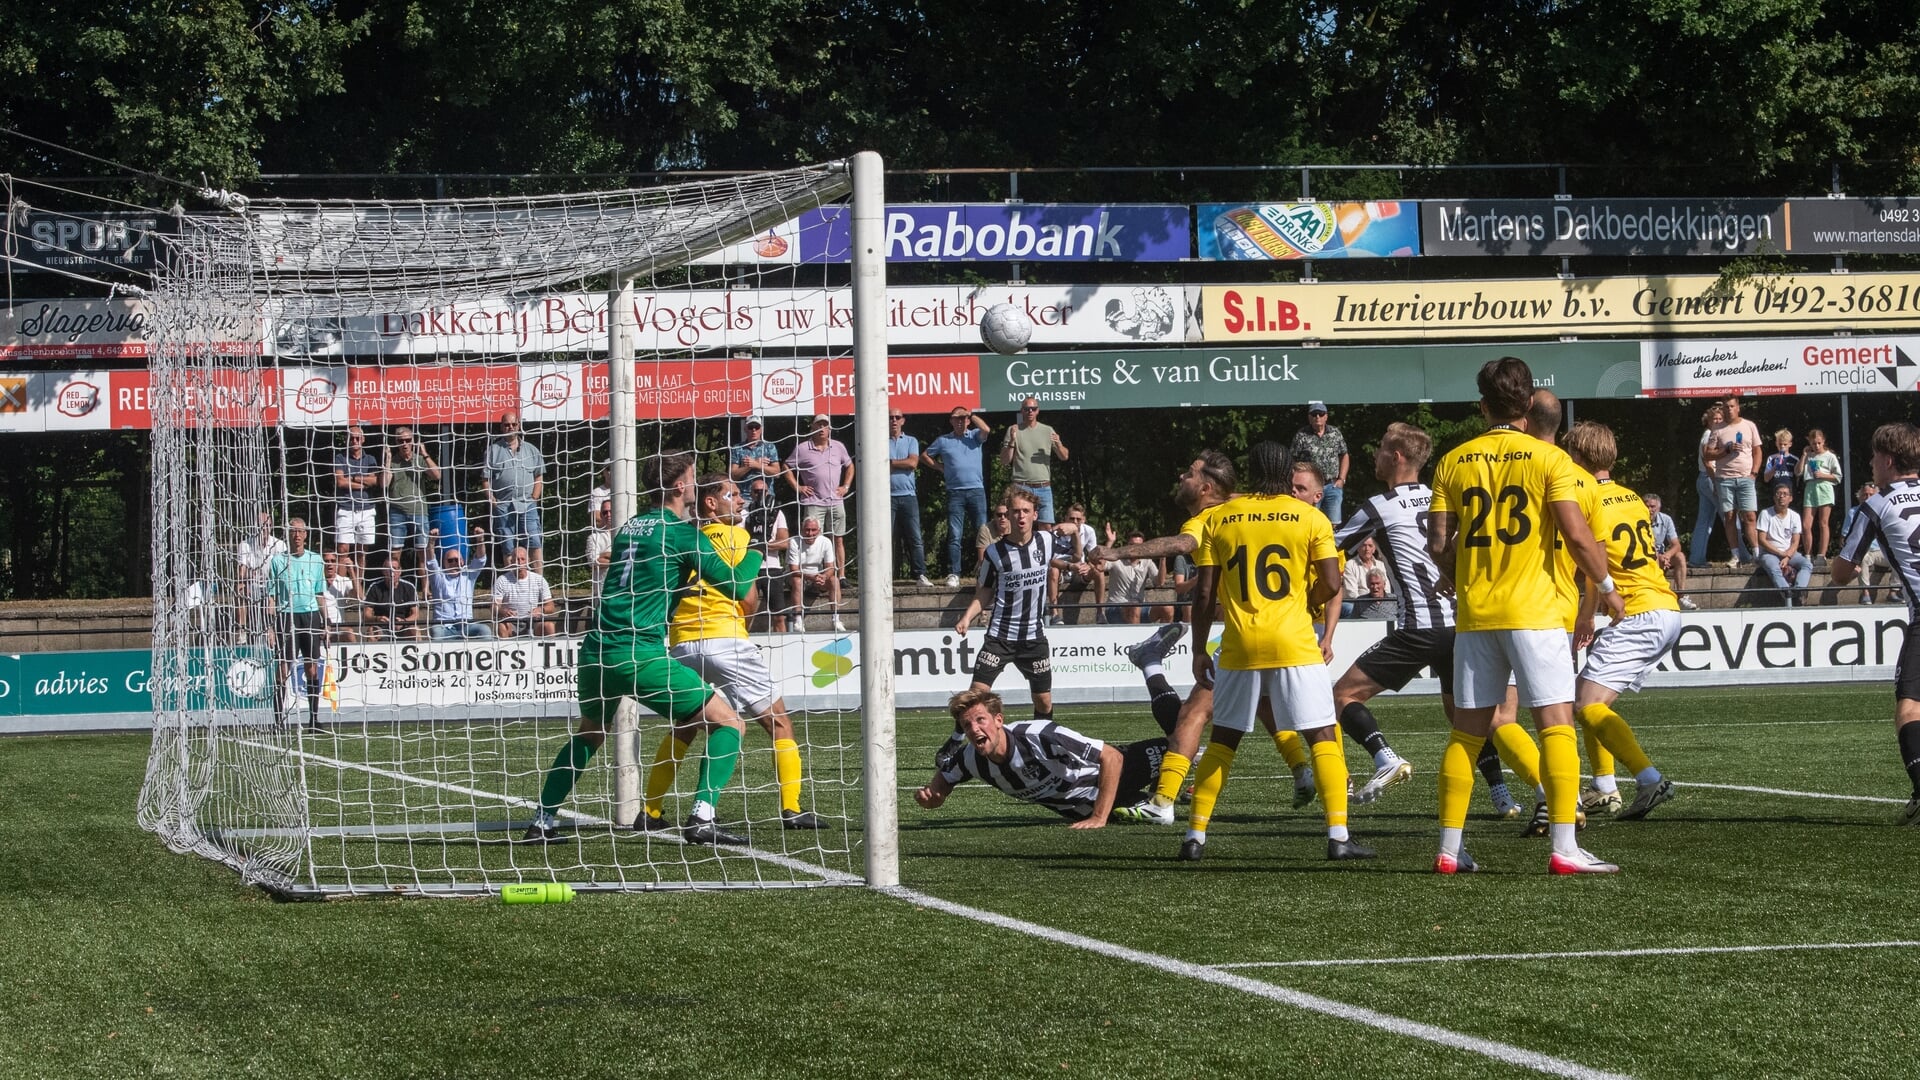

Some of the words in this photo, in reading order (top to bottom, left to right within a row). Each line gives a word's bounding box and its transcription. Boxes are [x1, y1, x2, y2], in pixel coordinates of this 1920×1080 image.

[1290, 209, 1322, 239] AA
[1880, 208, 1909, 223] 0492
[31, 219, 157, 252] SPORT
[886, 211, 1124, 257] Rabobank
[1275, 214, 1312, 249] DRINK
[1440, 206, 1545, 241] Martens
[1554, 205, 1772, 250] Dakbedekkingen
[46, 256, 97, 265] NIEUWSTRAAT
[634, 291, 753, 346] Vogels
[775, 309, 815, 330] uw
[1224, 290, 1311, 334] S.I.B.
[1333, 292, 1552, 323] Interieurbouw
[1563, 290, 1610, 318] b.v.
[1632, 288, 1744, 317] Gemert
[1655, 348, 1738, 368] Mediamakers
[1803, 344, 1893, 366] Gemert
[1006, 360, 1102, 387] Gerrits
[1112, 359, 1141, 386] &
[1152, 364, 1199, 384] van
[1208, 354, 1300, 384] Gulick
[1693, 365, 1713, 379] die
[1715, 358, 1789, 377] meedenken!
[354, 381, 377, 394] RED
[383, 380, 420, 393] LEMON
[425, 379, 452, 392] GELD
[458, 379, 472, 391] EN
[476, 377, 514, 391] GOEDE
[586, 376, 609, 389] RED
[656, 374, 683, 387] LAAT
[771, 378, 785, 386] RED
[771, 387, 795, 395] LEMON
[887, 371, 974, 395] EMON.NL
[66, 391, 80, 399] RED
[66, 400, 90, 409] LEMON
[304, 397, 328, 406] LEMON
[354, 398, 386, 411] RAAD
[391, 397, 422, 410] VOOR
[427, 395, 515, 409] ONDERNEMERS
[587, 390, 700, 406] ONDMERSCHAP
[703, 389, 750, 403] GROEIEN
[1008, 391, 1086, 402] NOTARISSEN
[1457, 453, 1481, 465] ART
[1485, 451, 1533, 463] IN.SIGN
[1221, 513, 1245, 526] ART
[1247, 512, 1300, 523] IN.SIGN
[1462, 485, 1532, 549] 23
[1612, 519, 1657, 570] 20
[619, 541, 640, 587] 1
[1227, 544, 1291, 602] 16
[894, 635, 975, 676] mit
[1052, 644, 1106, 657] rzame
[1656, 619, 1910, 672] everan
[336, 646, 388, 683] Jos
[401, 644, 526, 673] Somers
[538, 642, 581, 670] Tui
[1032, 658, 1050, 669] SYM
[35, 671, 109, 696] advies
[125, 670, 214, 693] Gemer
[379, 674, 445, 690] Zandhoek
[476, 673, 510, 687] 5427
[515, 673, 528, 689] PJ
[536, 671, 579, 685] Boeke
[475, 689, 579, 703] JosSomersTuinmac
